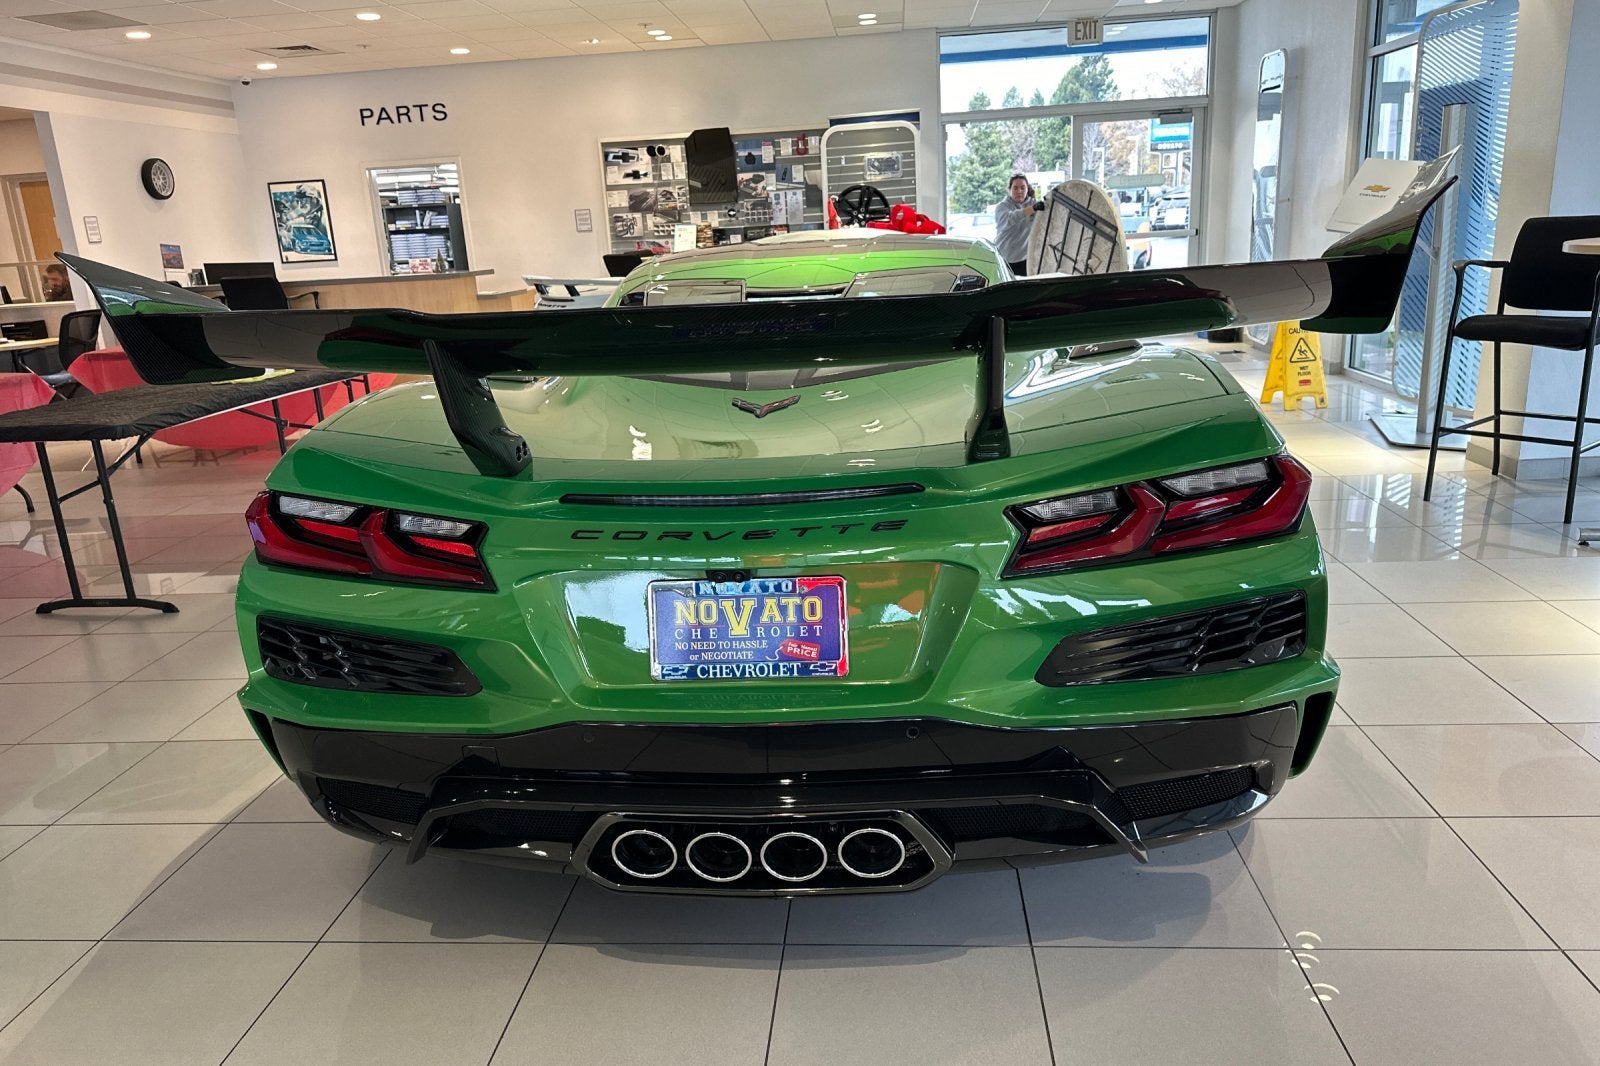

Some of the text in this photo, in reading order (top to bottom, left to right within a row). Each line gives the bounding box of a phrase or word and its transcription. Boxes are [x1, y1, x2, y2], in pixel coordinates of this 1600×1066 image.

[1074, 20, 1099, 41] EXIT
[359, 103, 449, 127] PARTS
[571, 519, 909, 542] CORVETTE
[699, 582, 793, 595] NOVATO
[674, 597, 823, 637] NOVATO
[675, 639, 768, 650] NO NEED TO HASSLE
[787, 646, 818, 659] PRICE
[689, 650, 754, 661] or NEGOTIATE
[696, 662, 802, 679] CHEVROLET
